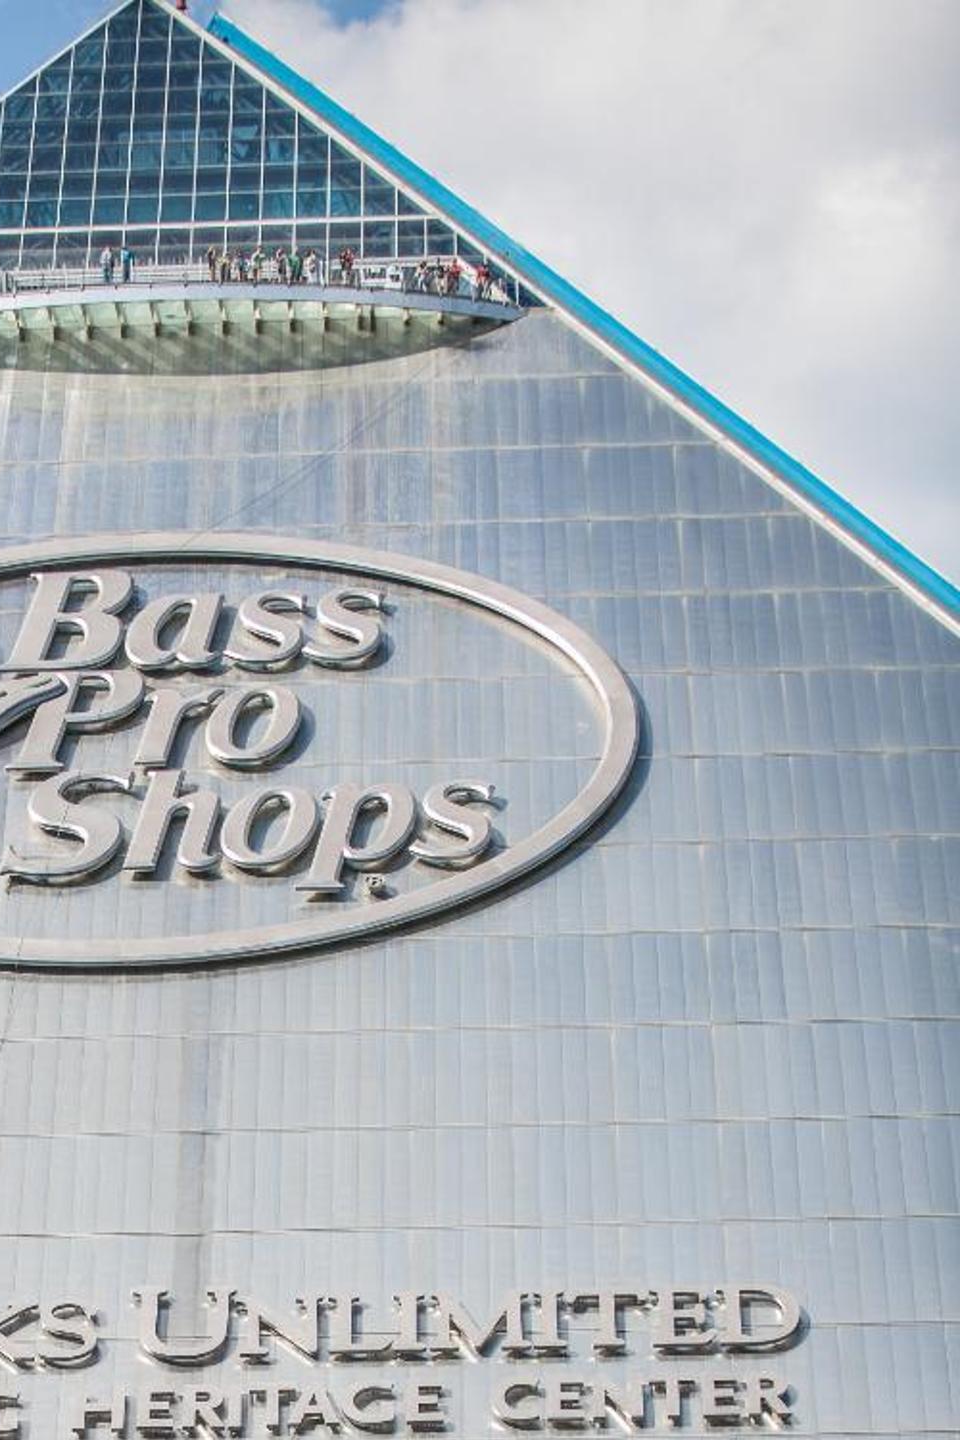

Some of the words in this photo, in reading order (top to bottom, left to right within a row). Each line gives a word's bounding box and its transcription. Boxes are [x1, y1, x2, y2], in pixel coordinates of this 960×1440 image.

[4, 670, 304, 772] Pro
[0, 769, 497, 893] Shops
[131, 1287, 807, 1366] UNLIMITED
[72, 1382, 448, 1440] HERITAGE
[490, 1375, 795, 1433] CENTER
